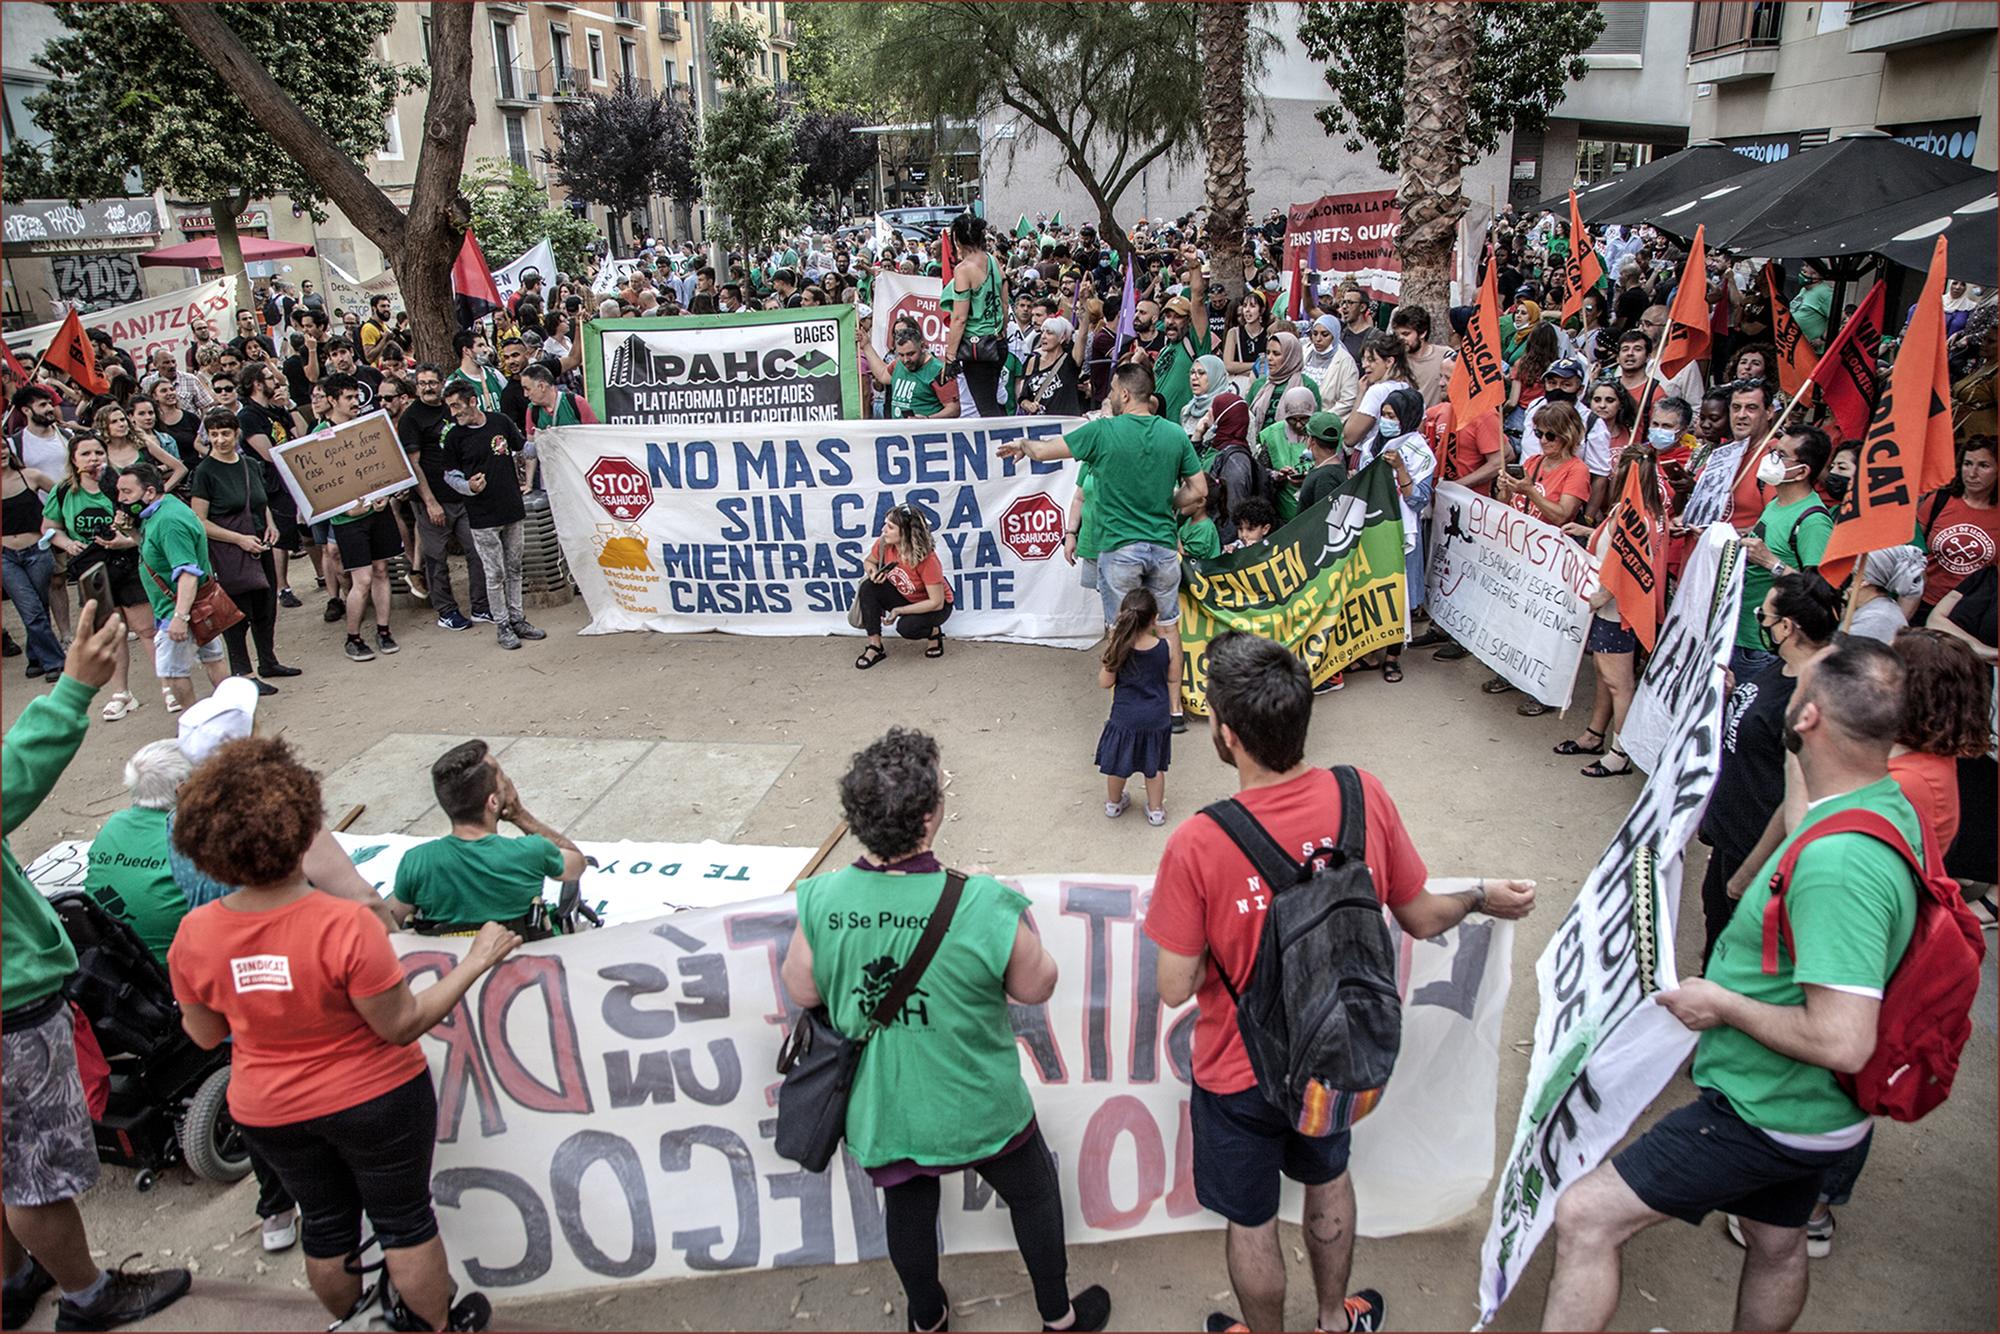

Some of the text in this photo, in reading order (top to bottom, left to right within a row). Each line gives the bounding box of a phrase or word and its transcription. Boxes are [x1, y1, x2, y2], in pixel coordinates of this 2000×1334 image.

[1365, 200, 1380, 213] LA
[916, 299, 936, 311] PAH
[794, 324, 835, 344] BAGES
[653, 348, 797, 383] PAHC
[634, 382, 815, 411] PLATAFORMA D'AFECTADES
[751, 404, 838, 423] CAPITALISME
[646, 424, 1064, 490] NO MAS GENTE
[592, 473, 644, 494] STOP
[716, 485, 983, 541] SIN CASA
[1007, 509, 1058, 533] STOP
[1009, 531, 1061, 544] DESAHUCIOS
[1468, 498, 1600, 602] BLACKSTONE
[662, 541, 865, 581] MIENTRAS
[669, 581, 793, 614] CASAS
[944, 570, 1015, 611] NTE
[97, 852, 112, 865] Se
[113, 852, 167, 870] Puede!
[704, 863, 751, 882] TE
[847, 911, 872, 929] Se
